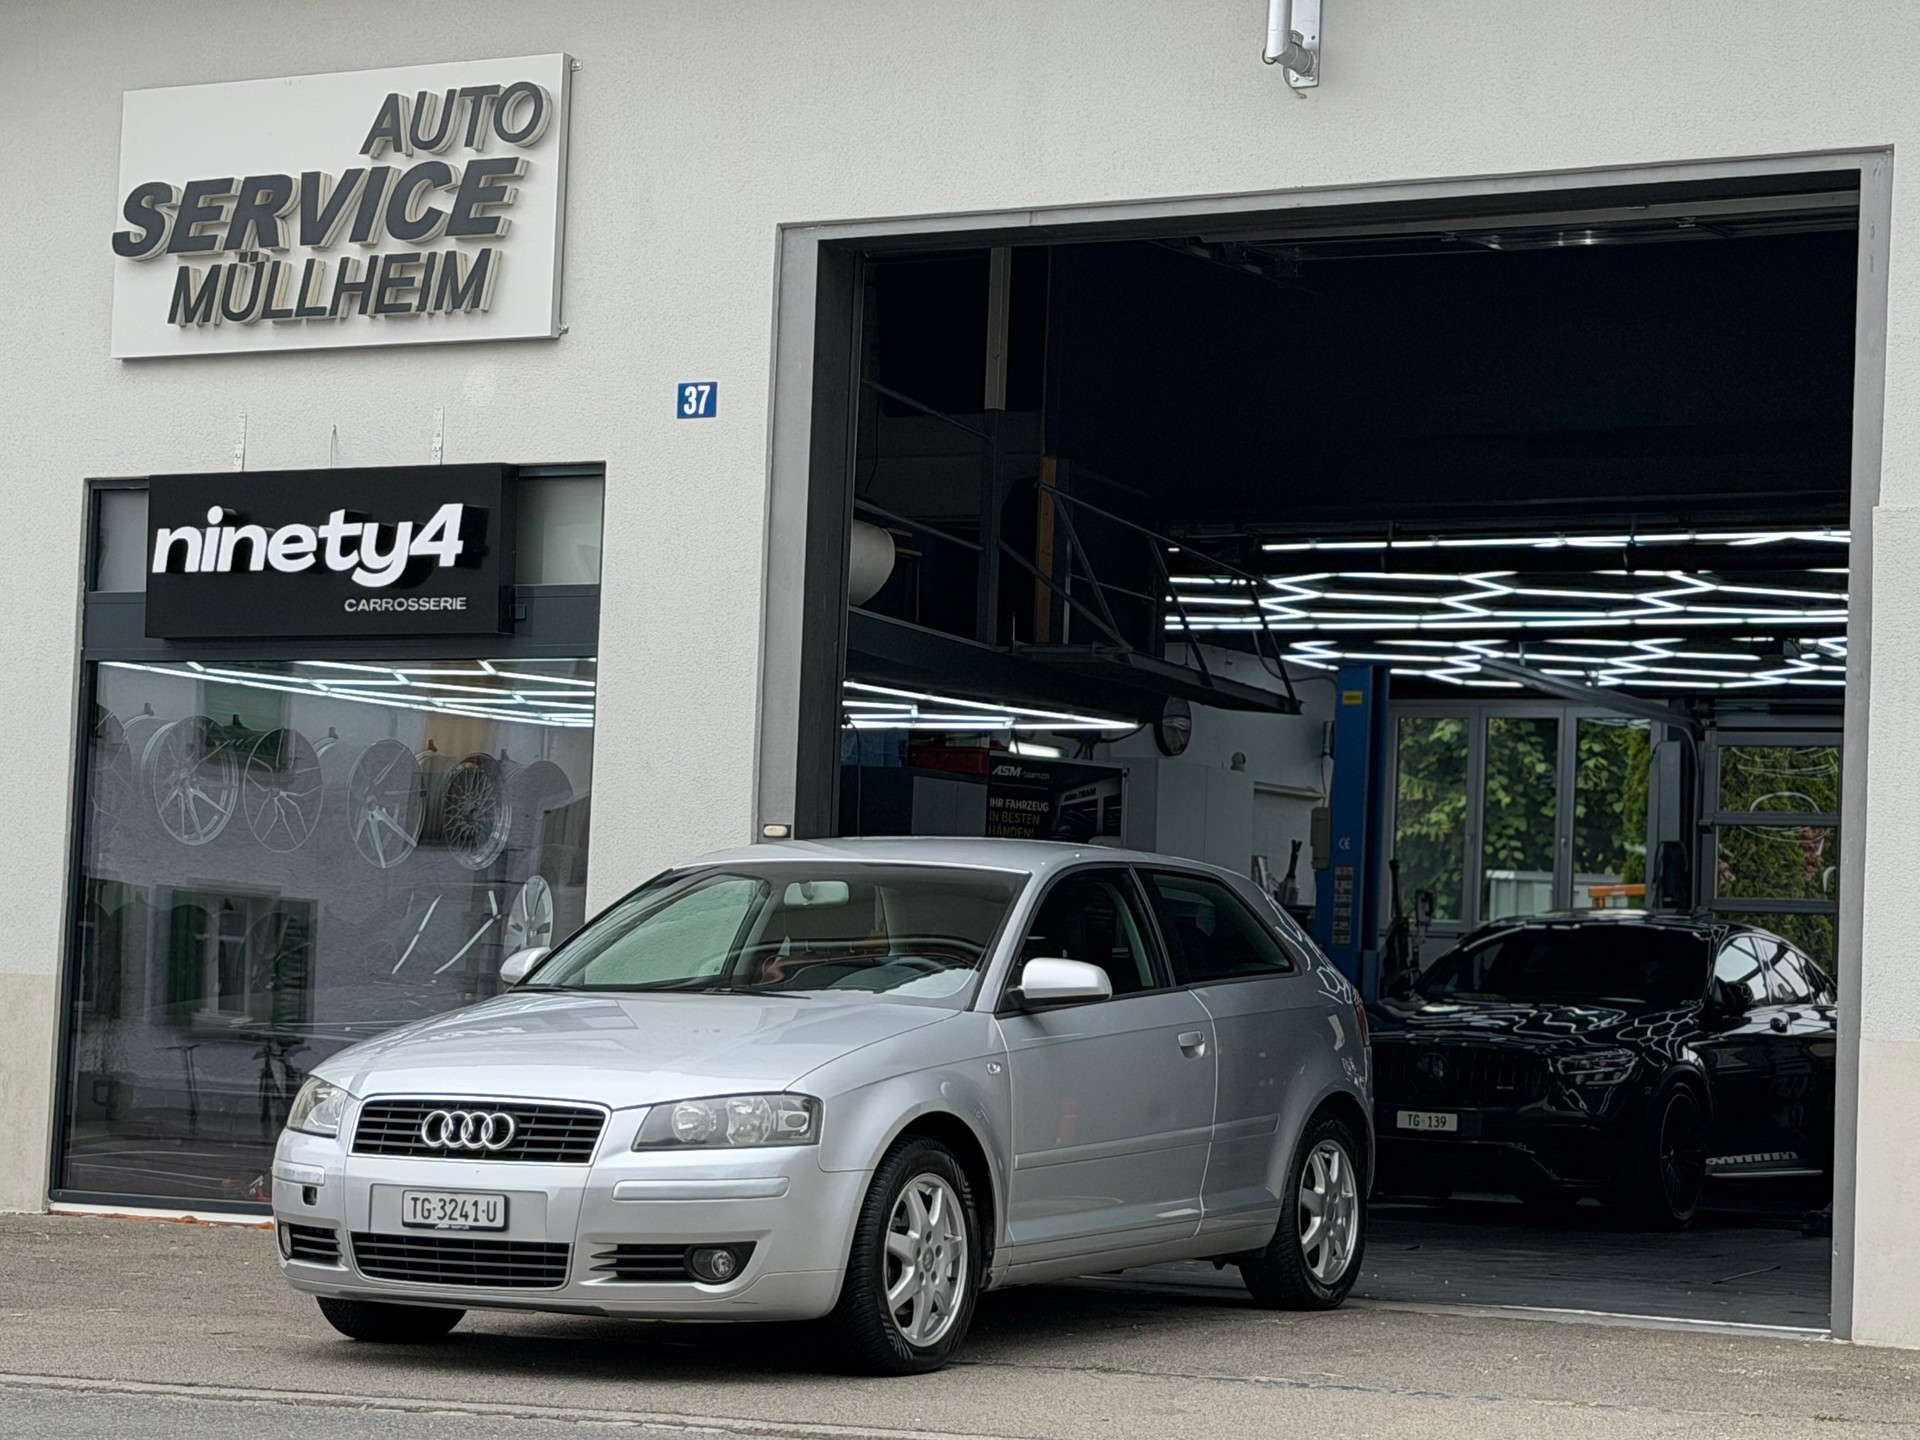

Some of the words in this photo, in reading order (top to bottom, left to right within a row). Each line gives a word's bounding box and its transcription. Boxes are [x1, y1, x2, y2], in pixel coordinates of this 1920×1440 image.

[359, 81, 552, 157] AUTO
[112, 157, 528, 260] SERVICE
[167, 248, 501, 327] MÜLLHEIM
[683, 385, 711, 415] 37
[152, 503, 464, 588] ninety4
[344, 597, 467, 612] CARROSSERIE
[989, 797, 1004, 809] IHR
[1005, 798, 1050, 813] FAHRZEUG
[989, 809, 999, 823] IN
[1001, 811, 1041, 826] BESTEN
